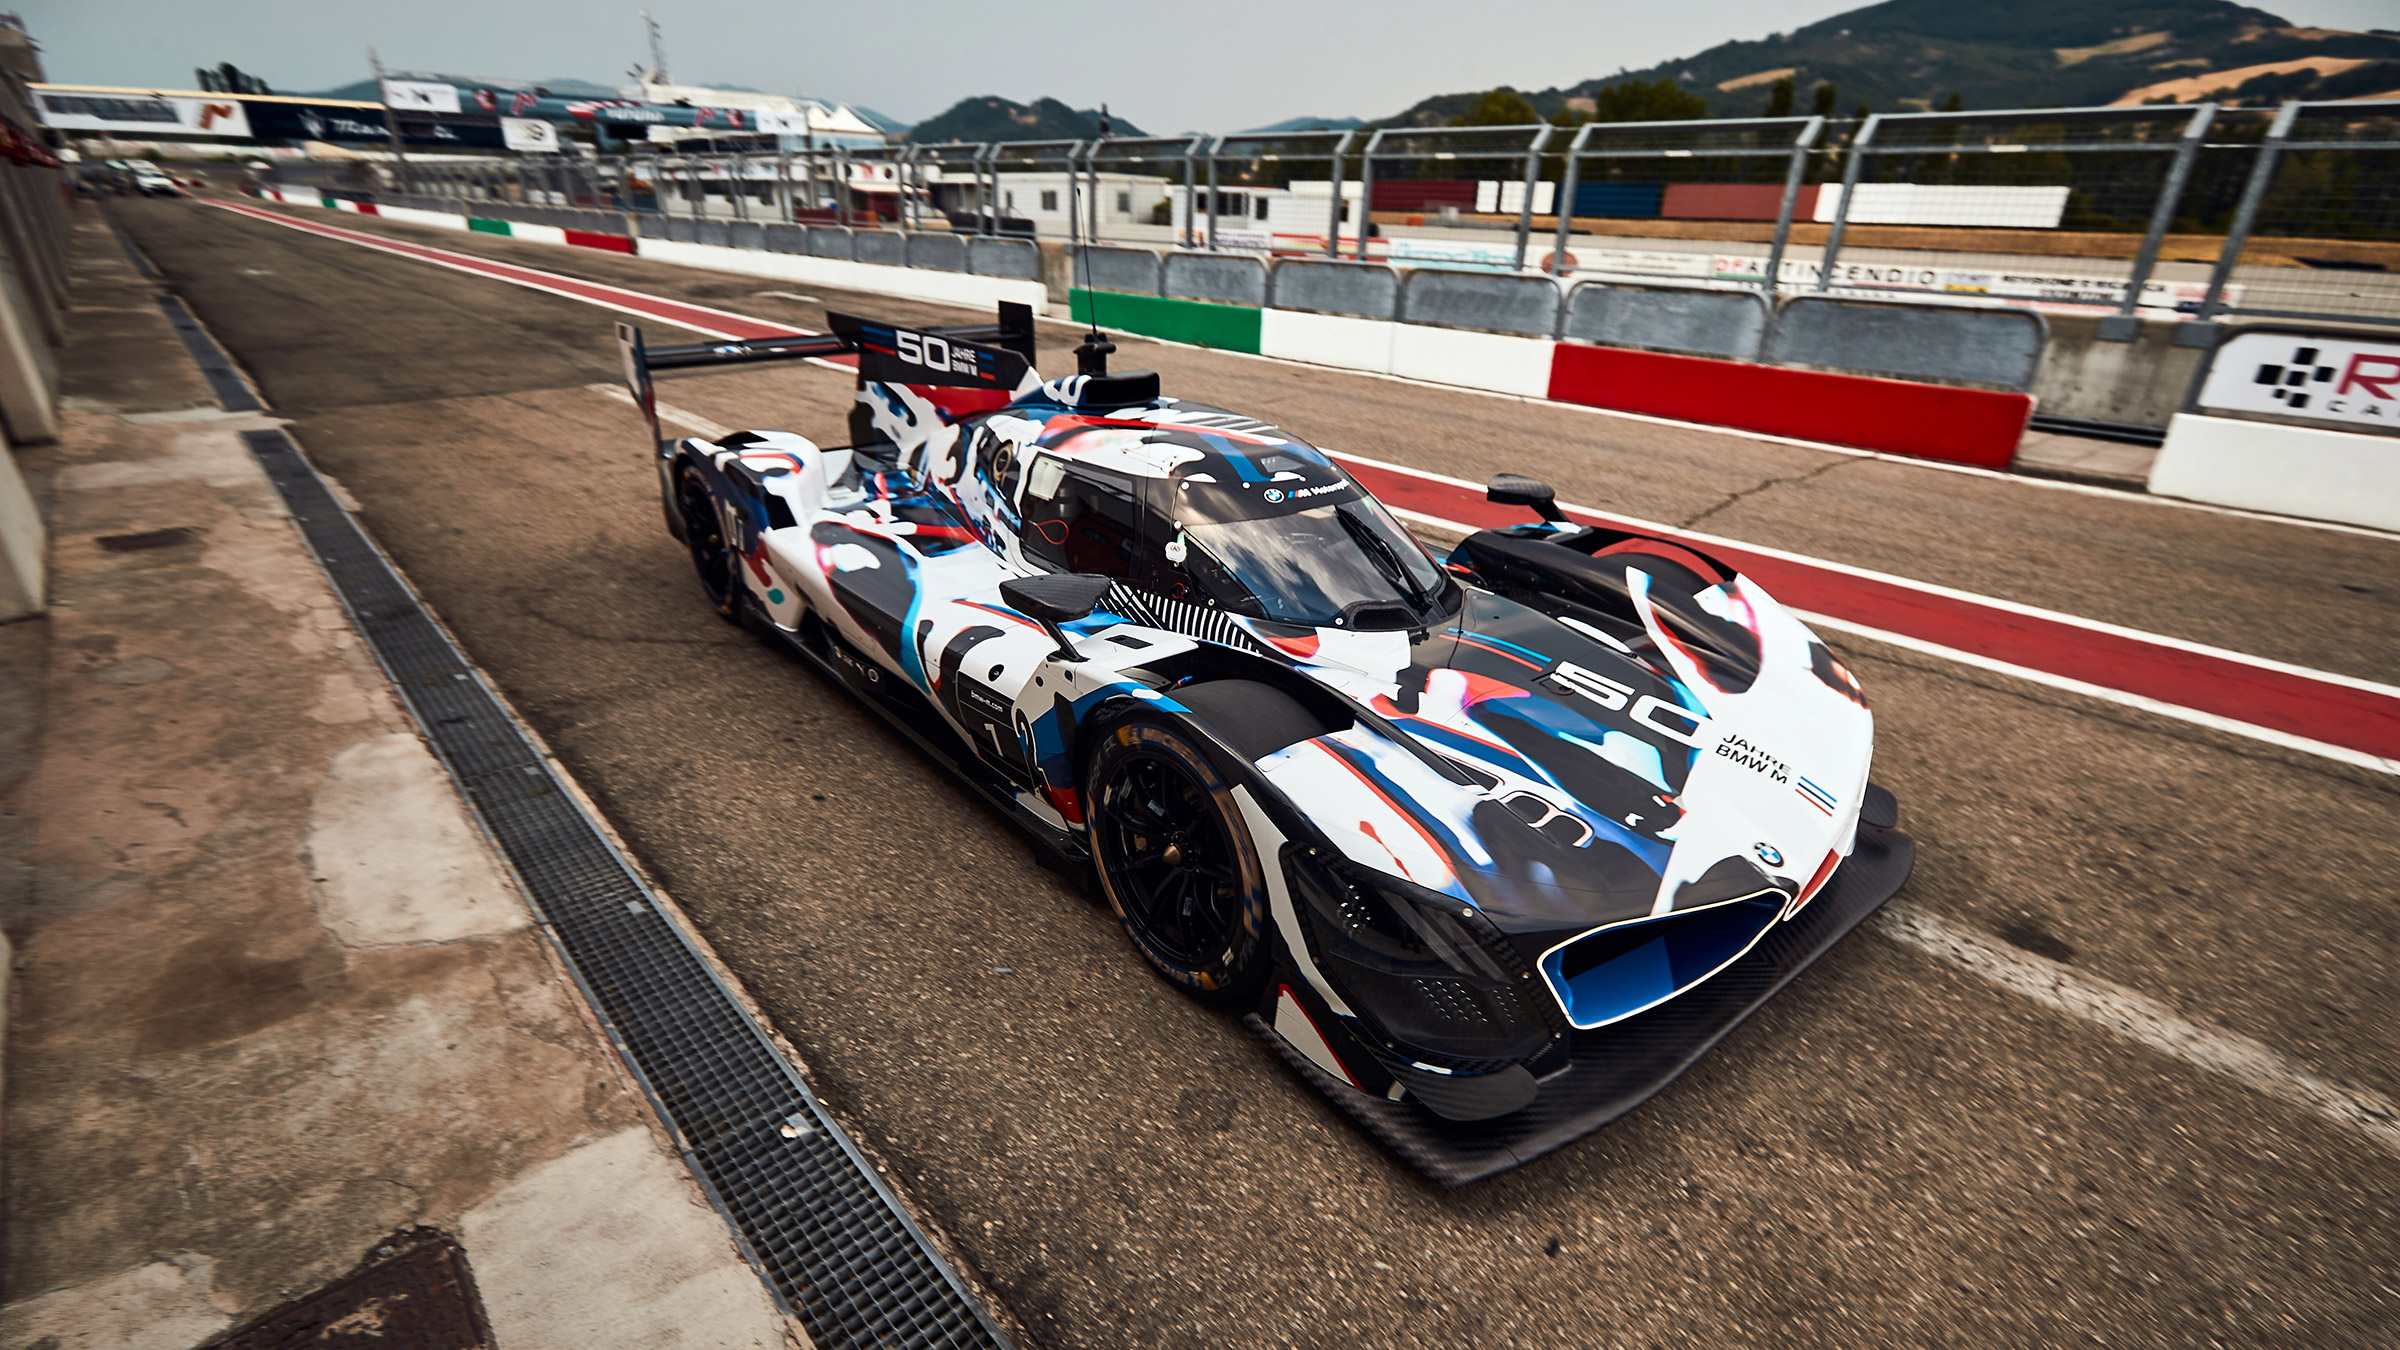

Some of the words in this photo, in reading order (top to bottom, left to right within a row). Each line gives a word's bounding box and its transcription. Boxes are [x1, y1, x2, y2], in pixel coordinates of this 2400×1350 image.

[895, 330, 951, 373] 50
[951, 347, 976, 363] JAHRE
[1549, 660, 1714, 751] 50
[1715, 744, 1769, 773] BMW
[1770, 769, 1788, 784] M
[1722, 734, 1792, 775] JAHRE
